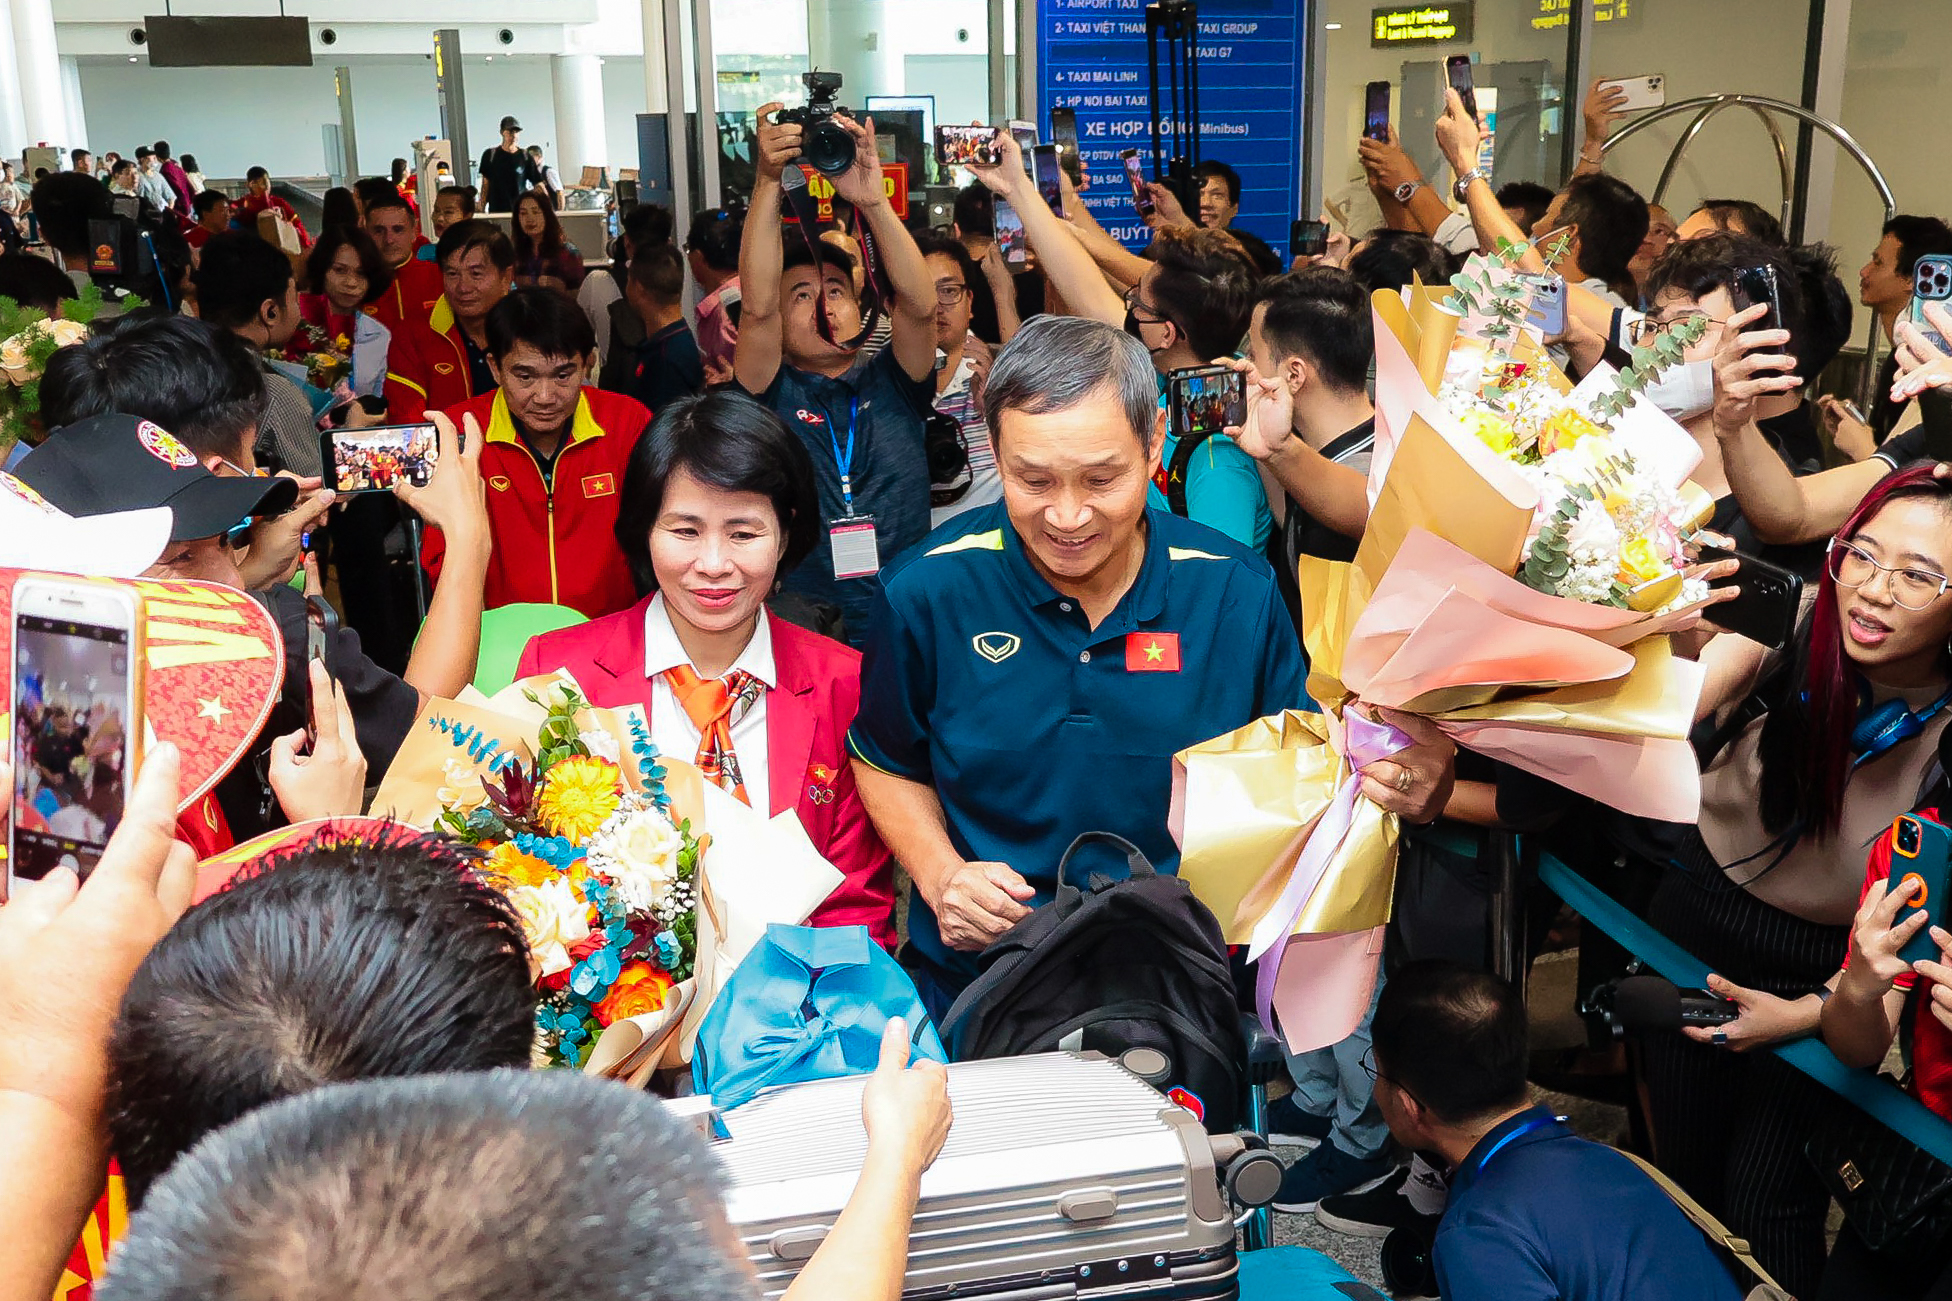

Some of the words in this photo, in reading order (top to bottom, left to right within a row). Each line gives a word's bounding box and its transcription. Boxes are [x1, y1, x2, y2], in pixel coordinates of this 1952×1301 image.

[1116, 0, 1139, 9] TAXI
[1067, 22, 1091, 34] TAXI
[1092, 19, 1116, 37] VIỆT
[1118, 22, 1147, 34] THAN
[1197, 22, 1220, 34] TAXI
[1222, 22, 1258, 34] GROUP
[1067, 71, 1091, 83] TAXI
[1093, 71, 1112, 83] MAI
[1114, 71, 1138, 83] LINH
[1067, 95, 1082, 107] HP
[1124, 95, 1148, 107] TAXI
[1085, 121, 1106, 136] XE
[1110, 120, 1144, 139] HỢP
[1092, 174, 1105, 185] BA
[1106, 174, 1124, 184] SAO
[1110, 222, 1150, 241] BUÝT
